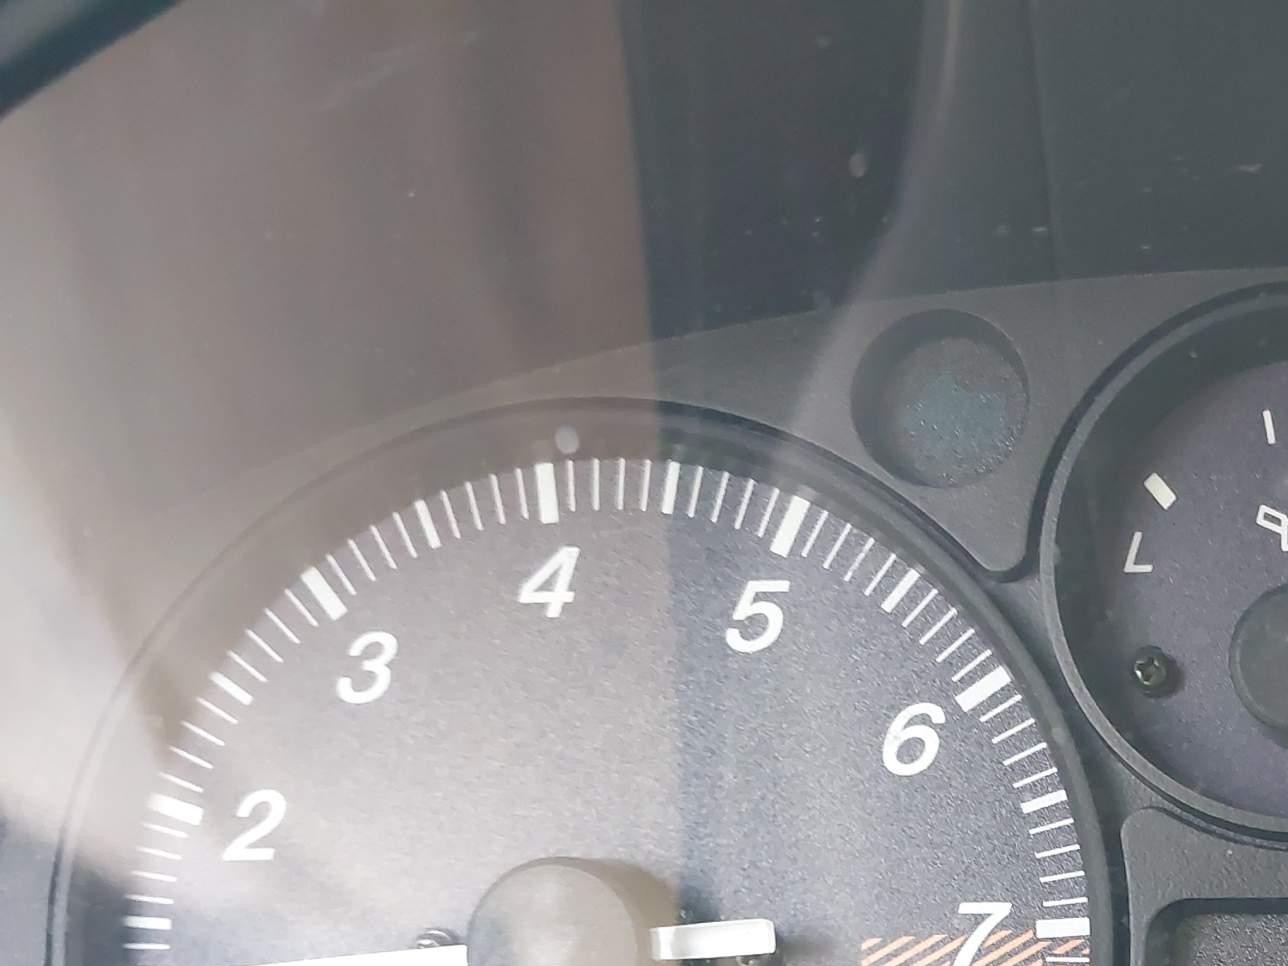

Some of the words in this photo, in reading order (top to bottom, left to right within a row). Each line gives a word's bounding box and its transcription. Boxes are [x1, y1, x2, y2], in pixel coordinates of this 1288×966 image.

[519, 546, 579, 617] 4
[1124, 532, 1153, 573] L
[725, 580, 789, 654] 5
[337, 631, 399, 704] 3
[882, 703, 948, 776] 6
[223, 789, 287, 862] 2
